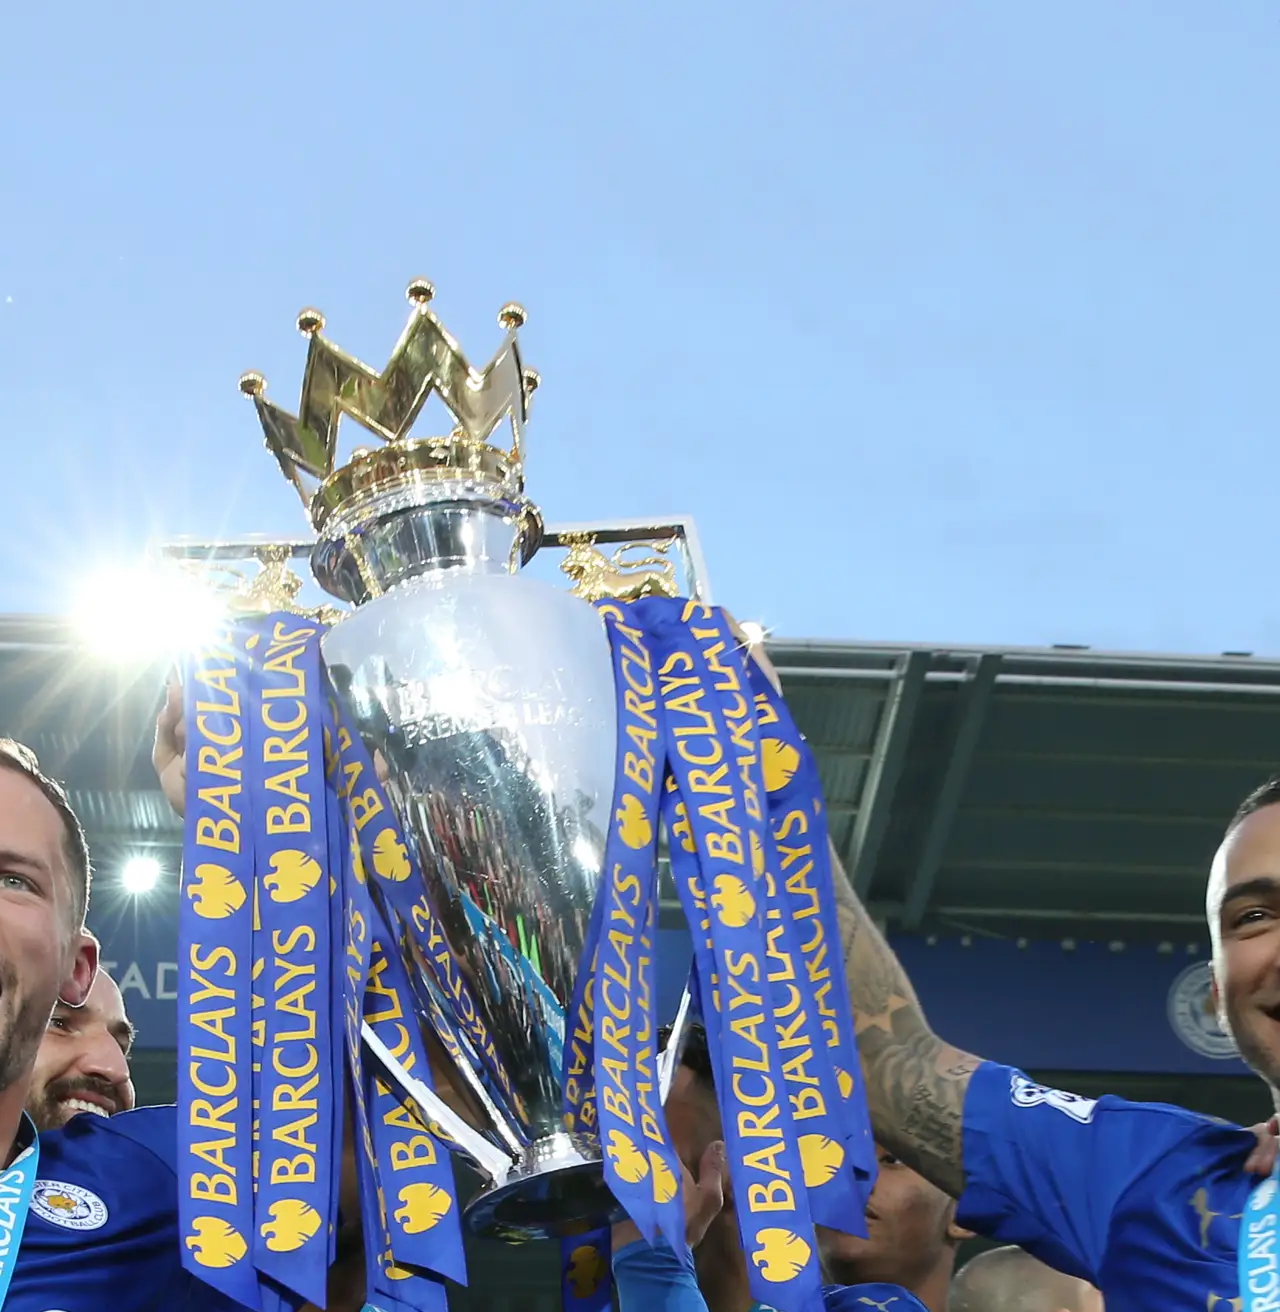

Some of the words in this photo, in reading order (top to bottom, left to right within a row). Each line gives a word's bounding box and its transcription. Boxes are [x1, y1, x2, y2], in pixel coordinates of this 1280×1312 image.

[195, 640, 244, 854] BARCLA
[658, 651, 745, 865] BARCLAYS
[189, 944, 238, 1205] BARCLAYS
[270, 925, 320, 1185] BARCLAYS
[601, 863, 641, 1126] BARCLAYS
[725, 949, 796, 1213] BARCLAYS
